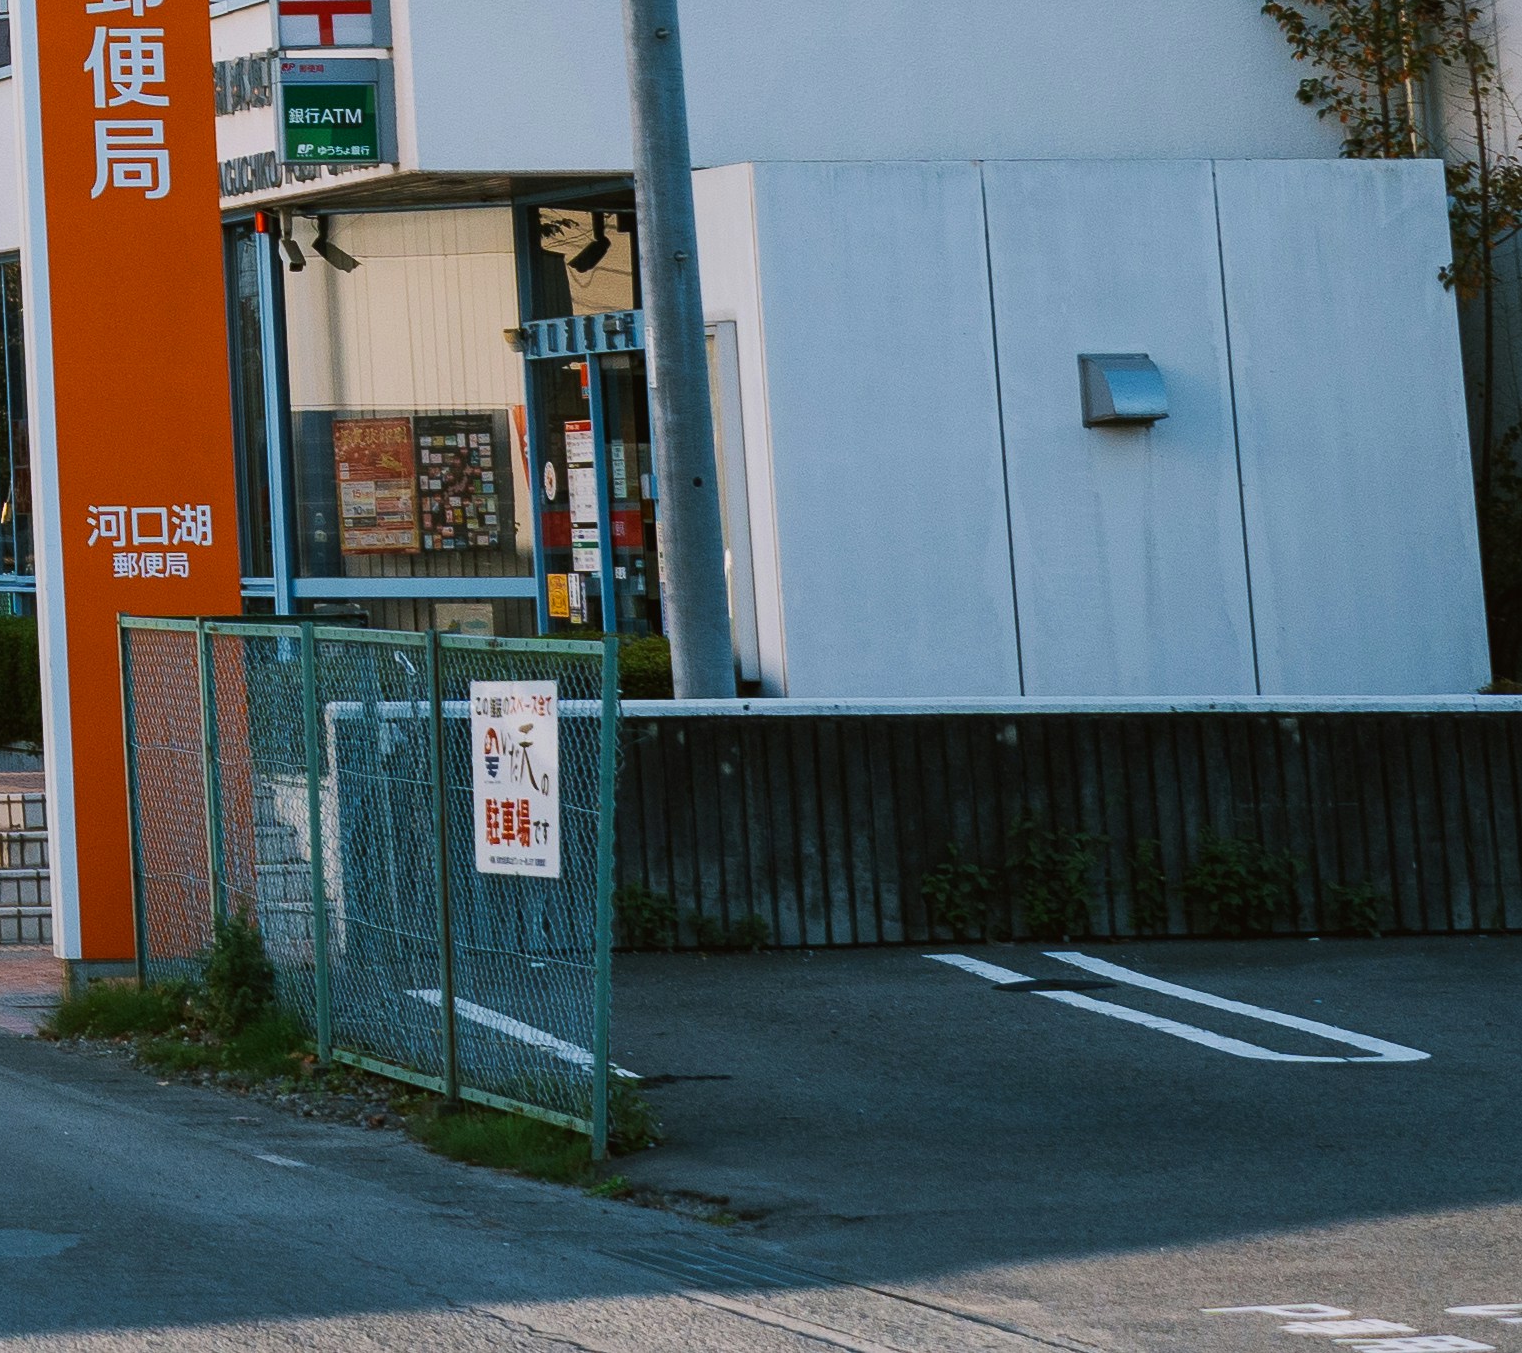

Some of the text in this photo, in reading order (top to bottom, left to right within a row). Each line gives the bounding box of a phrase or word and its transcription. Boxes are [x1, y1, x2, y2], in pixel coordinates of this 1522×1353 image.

[288, 108, 362, 124] 銀行ATM
[317, 145, 370, 156] ゆうちょ銀行
[86, 503, 213, 547] 河口湖
[113, 552, 189, 578] 郵便局
[485, 798, 550, 847] 駐車場です
